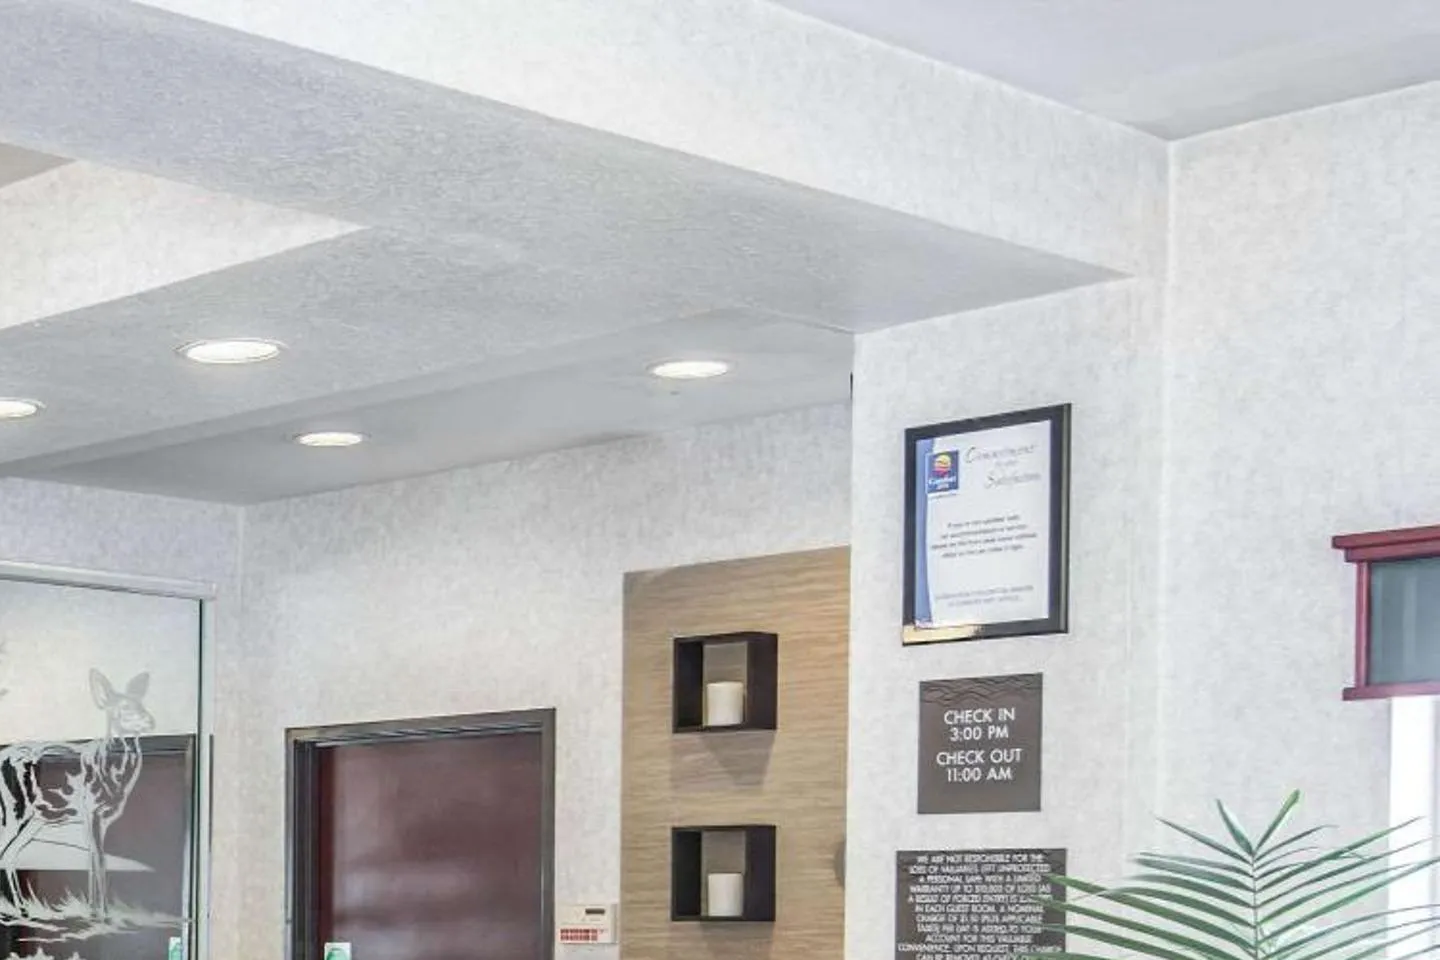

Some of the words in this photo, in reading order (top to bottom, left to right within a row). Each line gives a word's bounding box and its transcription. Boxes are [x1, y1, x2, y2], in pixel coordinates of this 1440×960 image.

[943, 708, 993, 725] CHECK
[998, 707, 1016, 721] IN
[950, 726, 982, 742] 3:00
[987, 725, 1009, 740] PM
[936, 750, 985, 766] CHECK
[990, 748, 1023, 763] OUT
[946, 767, 981, 783] 11:00
[986, 767, 1013, 781] AM
